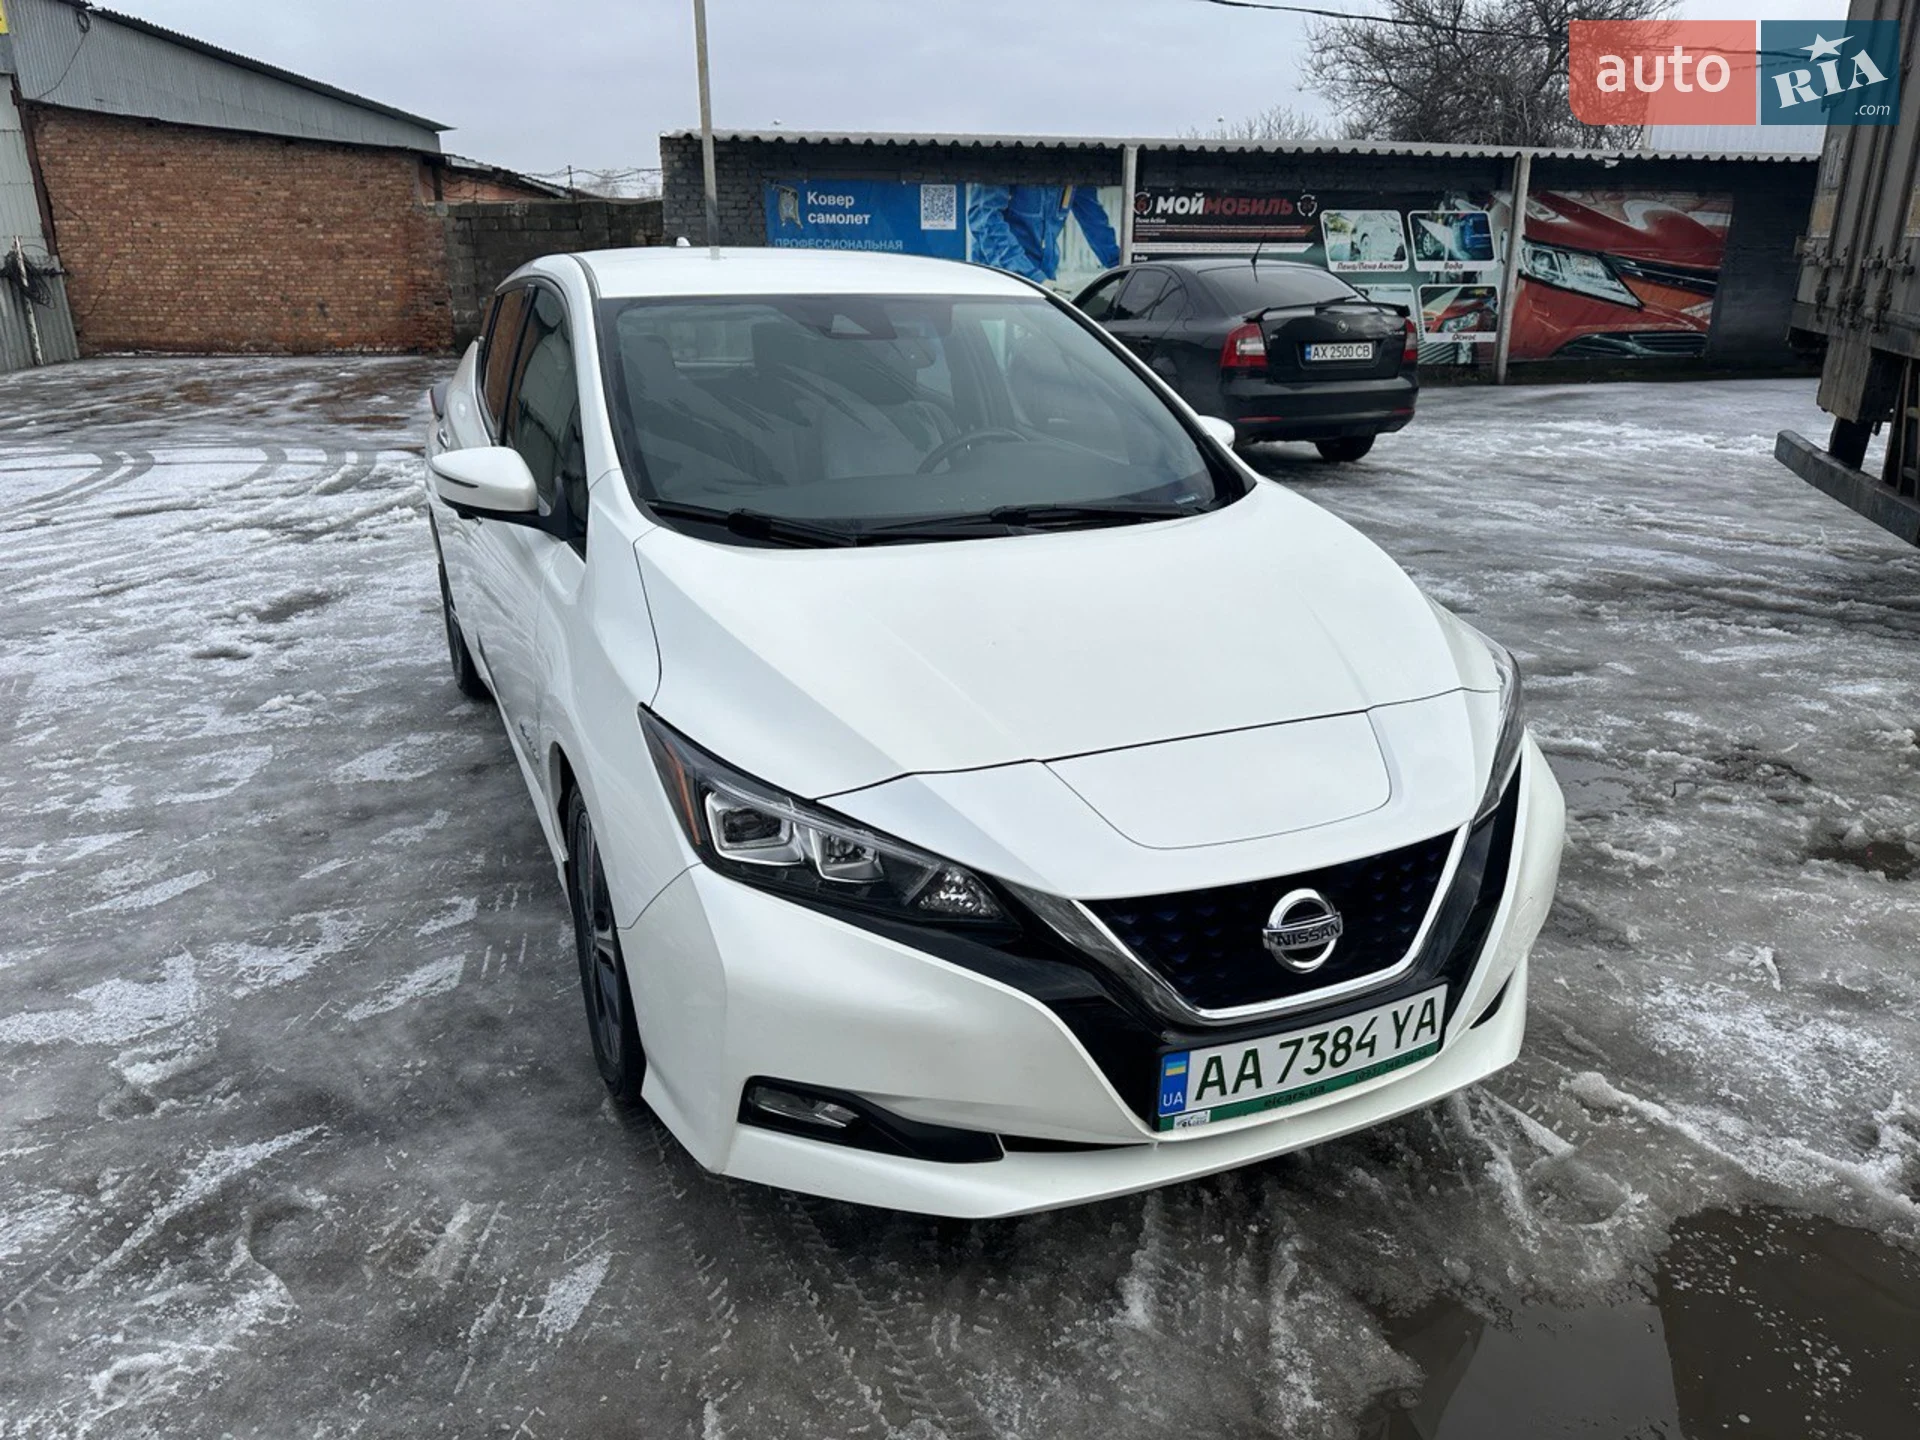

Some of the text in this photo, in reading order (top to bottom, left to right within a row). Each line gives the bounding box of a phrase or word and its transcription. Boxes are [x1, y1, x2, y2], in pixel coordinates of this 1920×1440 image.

[806, 191, 855, 208] Ковер
[1155, 192, 1294, 216] МОЙМОБИЛЬ
[807, 212, 871, 225] самолет
[774, 239, 904, 250] ПРОФЕССИОНАЛЬНАЯ
[1330, 345, 1354, 358] 2500
[1277, 923, 1340, 946] NISSAN
[1163, 1091, 1184, 1107] UA
[1194, 1047, 1264, 1101] AA
[1276, 1016, 1379, 1084] 7384
[1391, 996, 1437, 1049] YA
